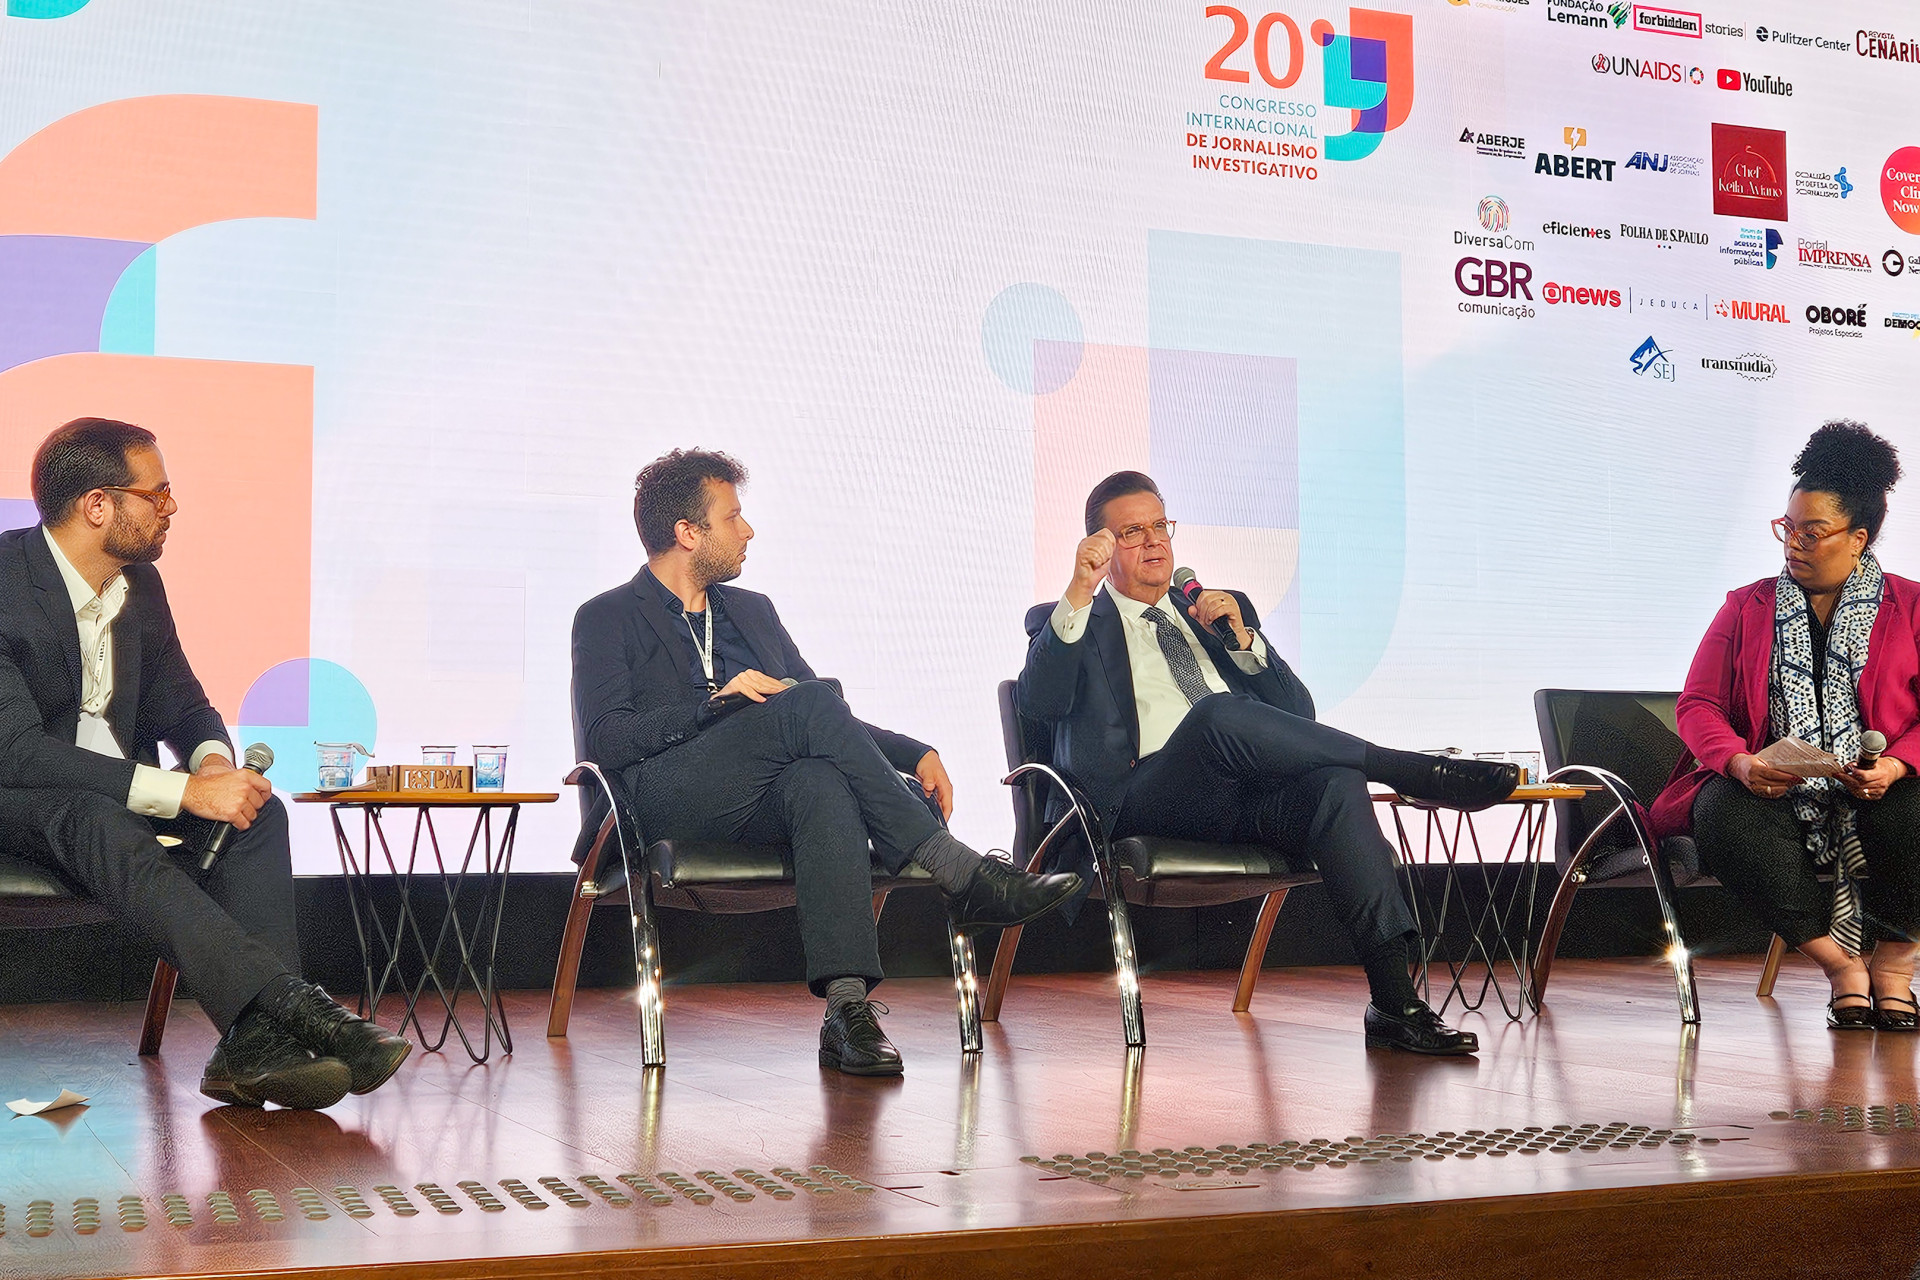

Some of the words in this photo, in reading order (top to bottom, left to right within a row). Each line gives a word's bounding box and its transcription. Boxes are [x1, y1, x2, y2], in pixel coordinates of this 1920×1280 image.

[1547, 6, 1608, 29] Lemann
[1637, 12, 1698, 32] forbidden
[1704, 22, 1744, 38] stories
[1771, 30, 1814, 47] Pulitzer
[1814, 37, 1851, 52] Center
[1612, 56, 1682, 83] UNAIDS
[1742, 72, 1793, 97] YouTube
[1219, 94, 1318, 118] CONGRESSO
[1186, 111, 1319, 140] INTERNACIONAL
[1186, 132, 1209, 149] DE
[1211, 136, 1319, 160] JORNALISMO
[1476, 133, 1526, 150] ABERJE
[1192, 154, 1319, 180] INVESTIGATIVO
[1535, 152, 1617, 182] ABERT
[1625, 151, 1668, 173] ANJ
[1735, 163, 1762, 179] Chef
[1900, 185, 1920, 200] Cli
[1892, 199, 1919, 214] Now
[1454, 231, 1535, 251] DiversaCom
[1620, 223, 1654, 240] FOLHA
[1655, 228, 1669, 242] DE
[1798, 238, 1828, 251] Portal
[1798, 248, 1872, 269] IMPRENSA
[1454, 256, 1534, 301] GBR
[1562, 285, 1622, 308] news
[1458, 301, 1536, 320] comunicação
[1731, 300, 1791, 323] MURAL
[1805, 303, 1868, 328] OBORÉ
[1653, 362, 1676, 383] SEJ
